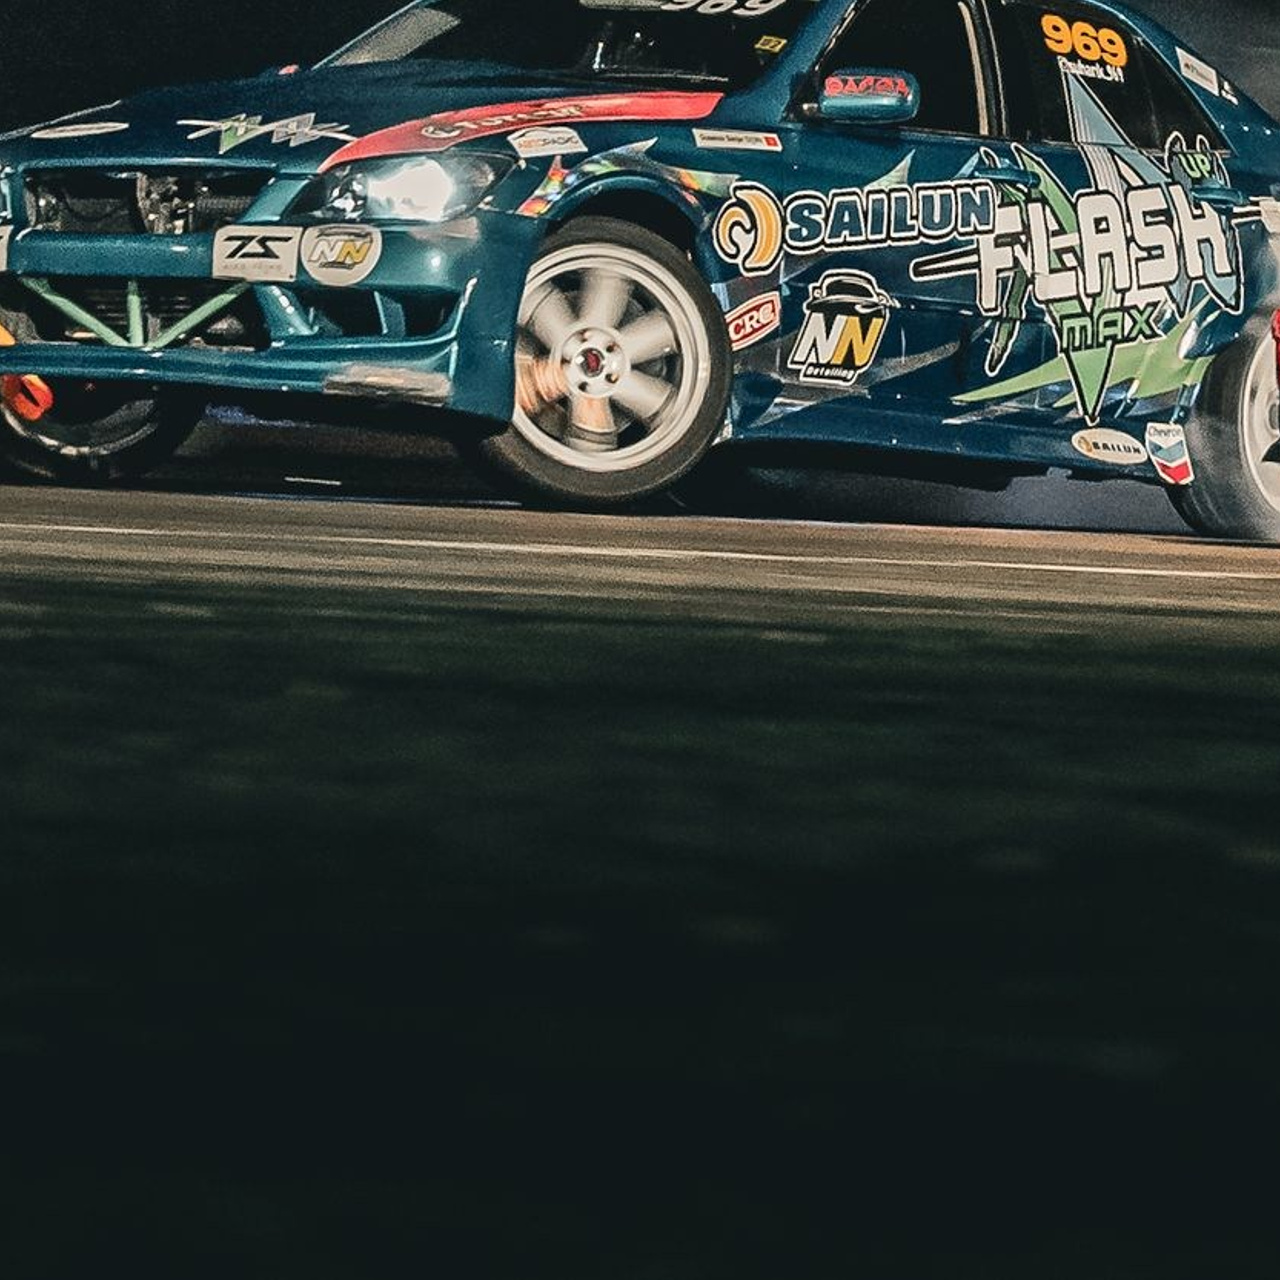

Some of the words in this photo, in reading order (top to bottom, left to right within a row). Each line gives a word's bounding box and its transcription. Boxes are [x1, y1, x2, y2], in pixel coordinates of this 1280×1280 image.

[1041, 14, 1128, 67] 969
[1178, 153, 1211, 179] UP
[785, 186, 994, 249] SAILUN
[308, 238, 372, 265] NN
[978, 184, 1233, 310] FLASH
[792, 312, 884, 367] NN
[1062, 305, 1155, 349] MAX
[1091, 440, 1142, 455] SAILUN
